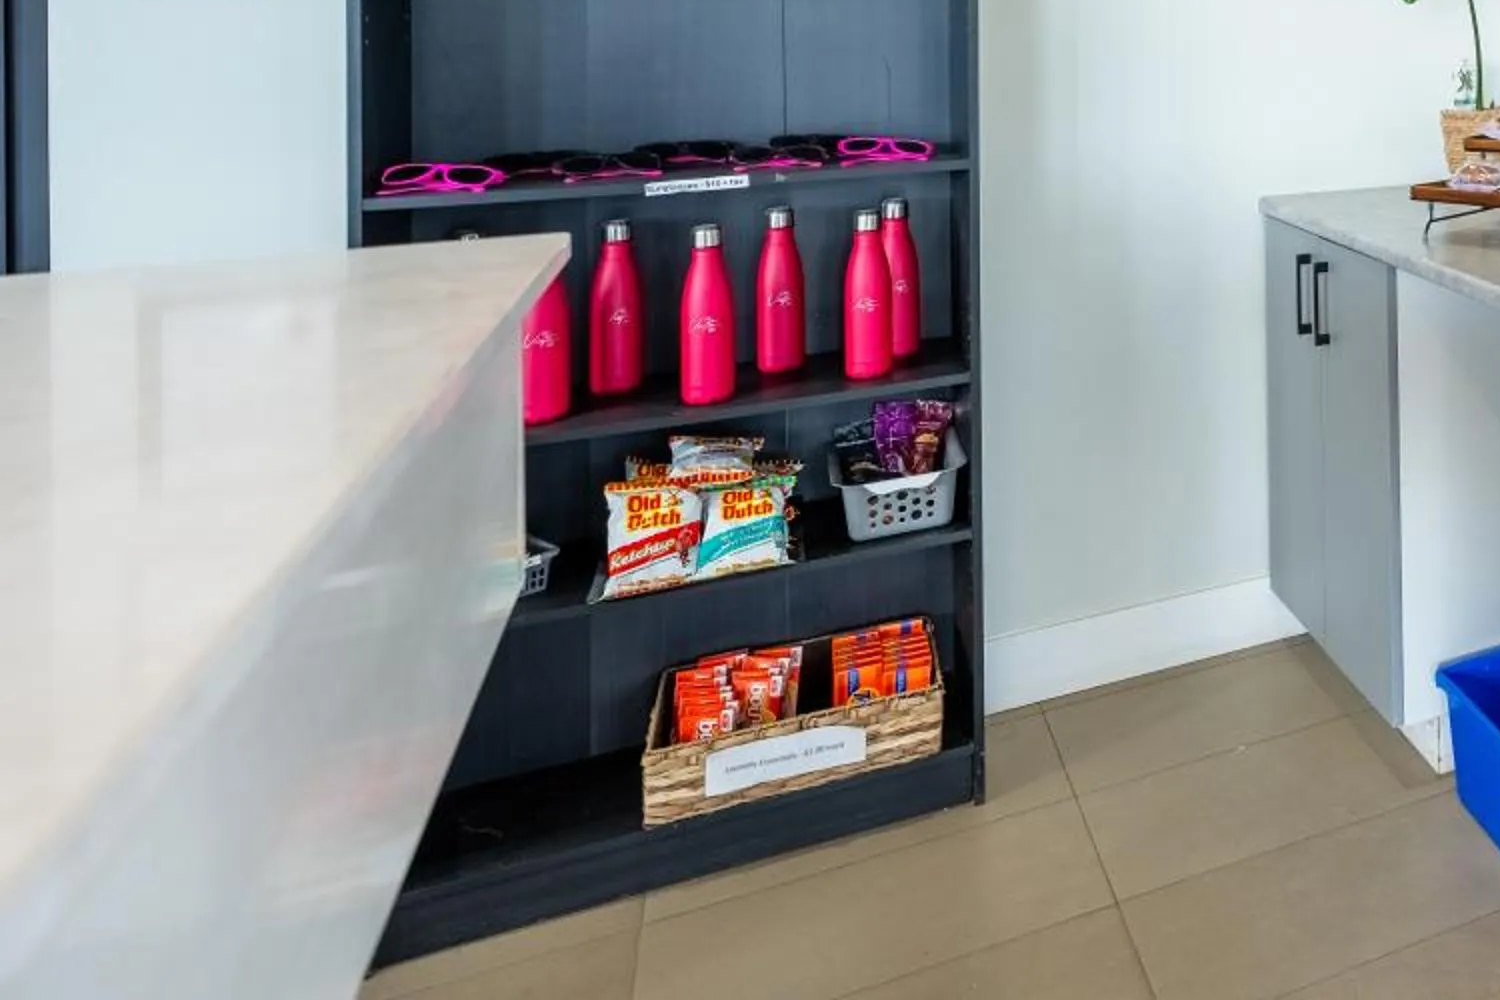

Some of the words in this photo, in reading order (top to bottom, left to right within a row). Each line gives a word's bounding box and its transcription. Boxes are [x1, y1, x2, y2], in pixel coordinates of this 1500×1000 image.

[627, 494, 662, 513] Old
[722, 488, 753, 505] Old
[627, 509, 681, 531] Dutch
[722, 500, 774, 521] Dutch
